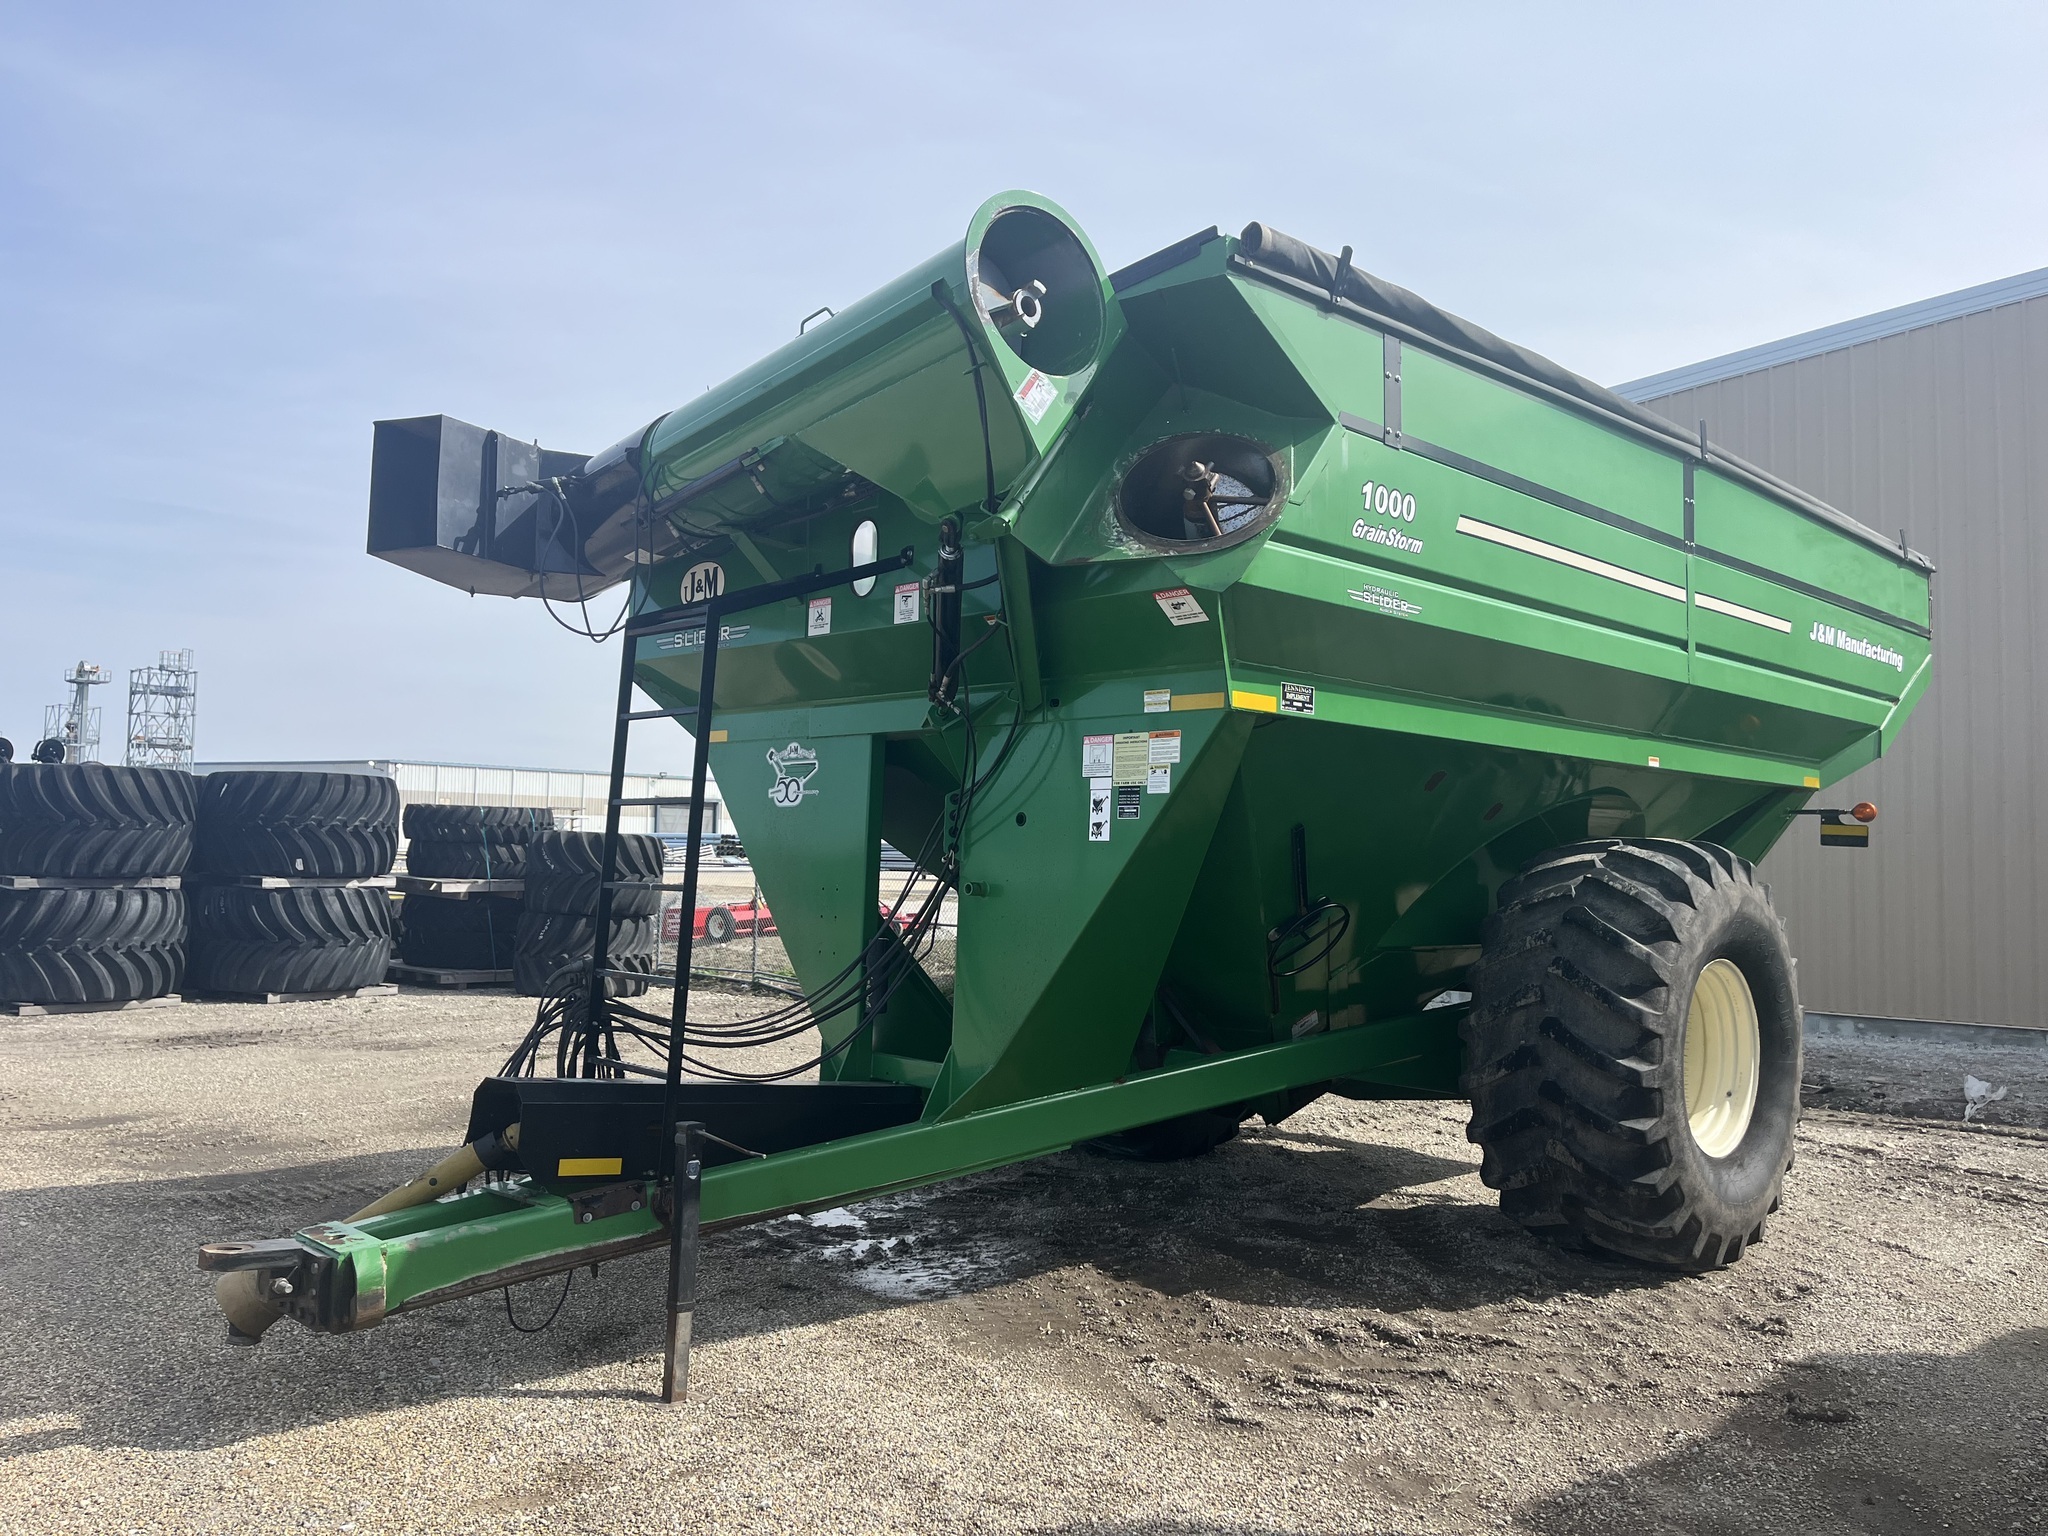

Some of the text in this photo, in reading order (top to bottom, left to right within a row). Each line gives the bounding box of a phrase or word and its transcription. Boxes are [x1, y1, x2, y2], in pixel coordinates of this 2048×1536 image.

[1361, 480, 1416, 523] 1000
[1352, 518, 1424, 554] GrainStorm
[684, 566, 719, 603] J&M
[899, 582, 919, 591] DANGER
[1160, 589, 1190, 599] DANGER
[1363, 583, 1399, 598] HYDRAULIC
[813, 598, 831, 607] DANGER
[1363, 591, 1408, 612] SLIDER
[674, 626, 729, 648] SLIDR
[1809, 621, 1903, 673] J&M Manufacturing
[1284, 684, 1312, 694] JENNINGS
[1089, 736, 1113, 744] DANGER
[776, 776, 801, 803] 50
